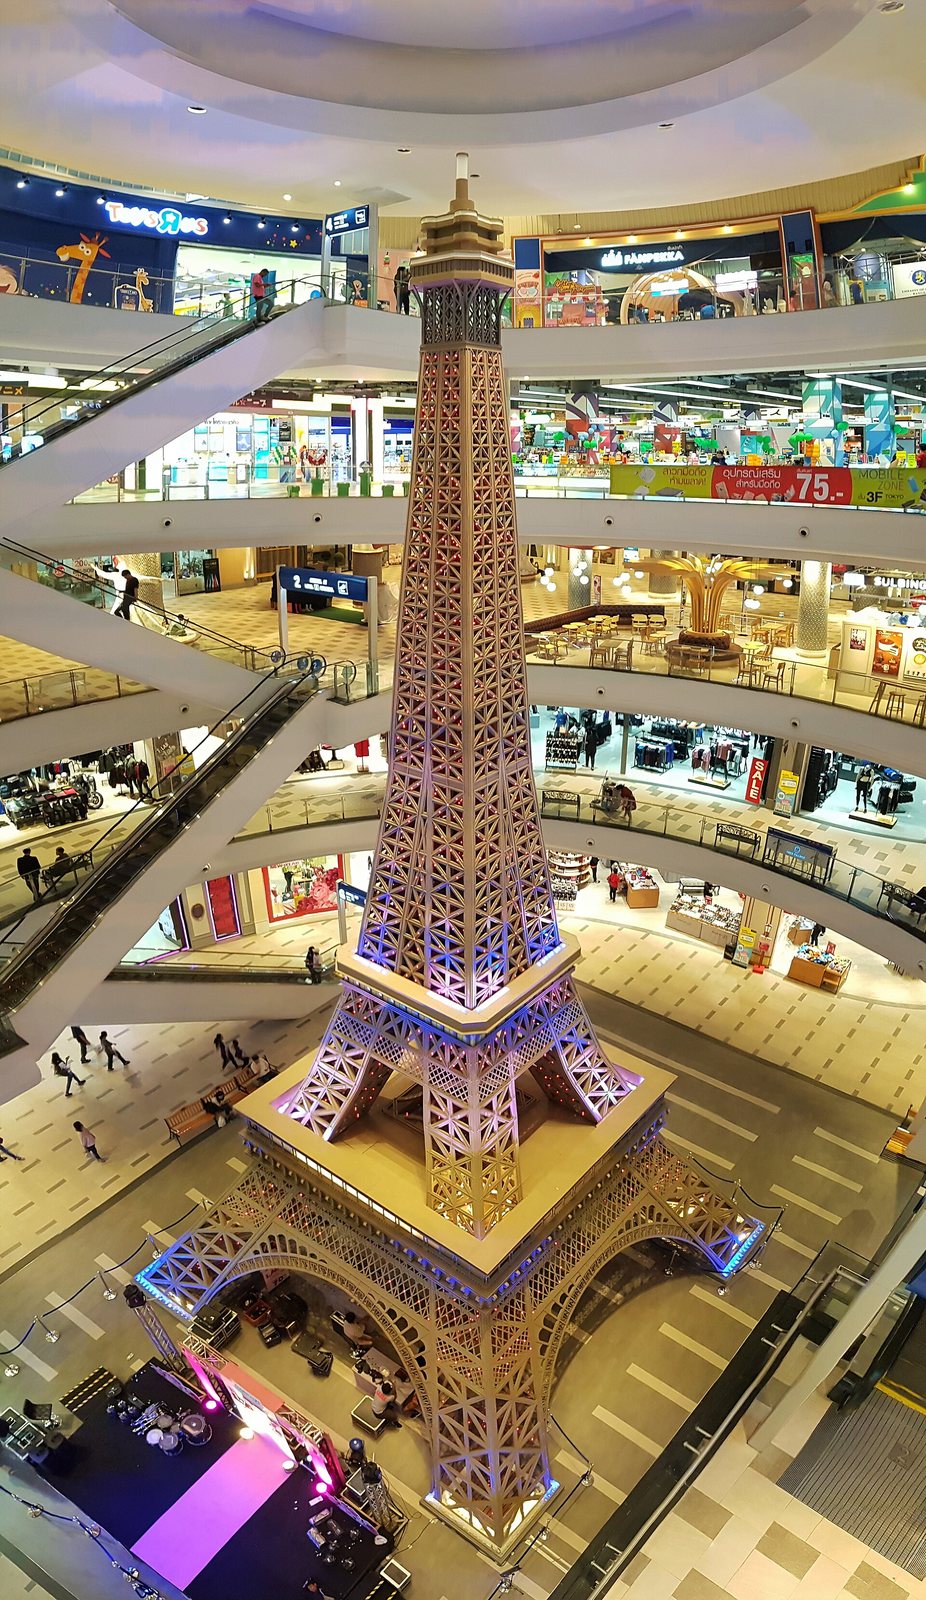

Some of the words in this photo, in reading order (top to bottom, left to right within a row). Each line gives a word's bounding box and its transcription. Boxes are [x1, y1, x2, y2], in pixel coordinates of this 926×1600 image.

[326, 217, 333, 231] 4
[858, 468, 904, 481] MOBILE
[877, 480, 904, 491] ZONE
[866, 491, 883, 503] 3F
[293, 574, 302, 588] 2
[749, 761, 765, 799] SALE
